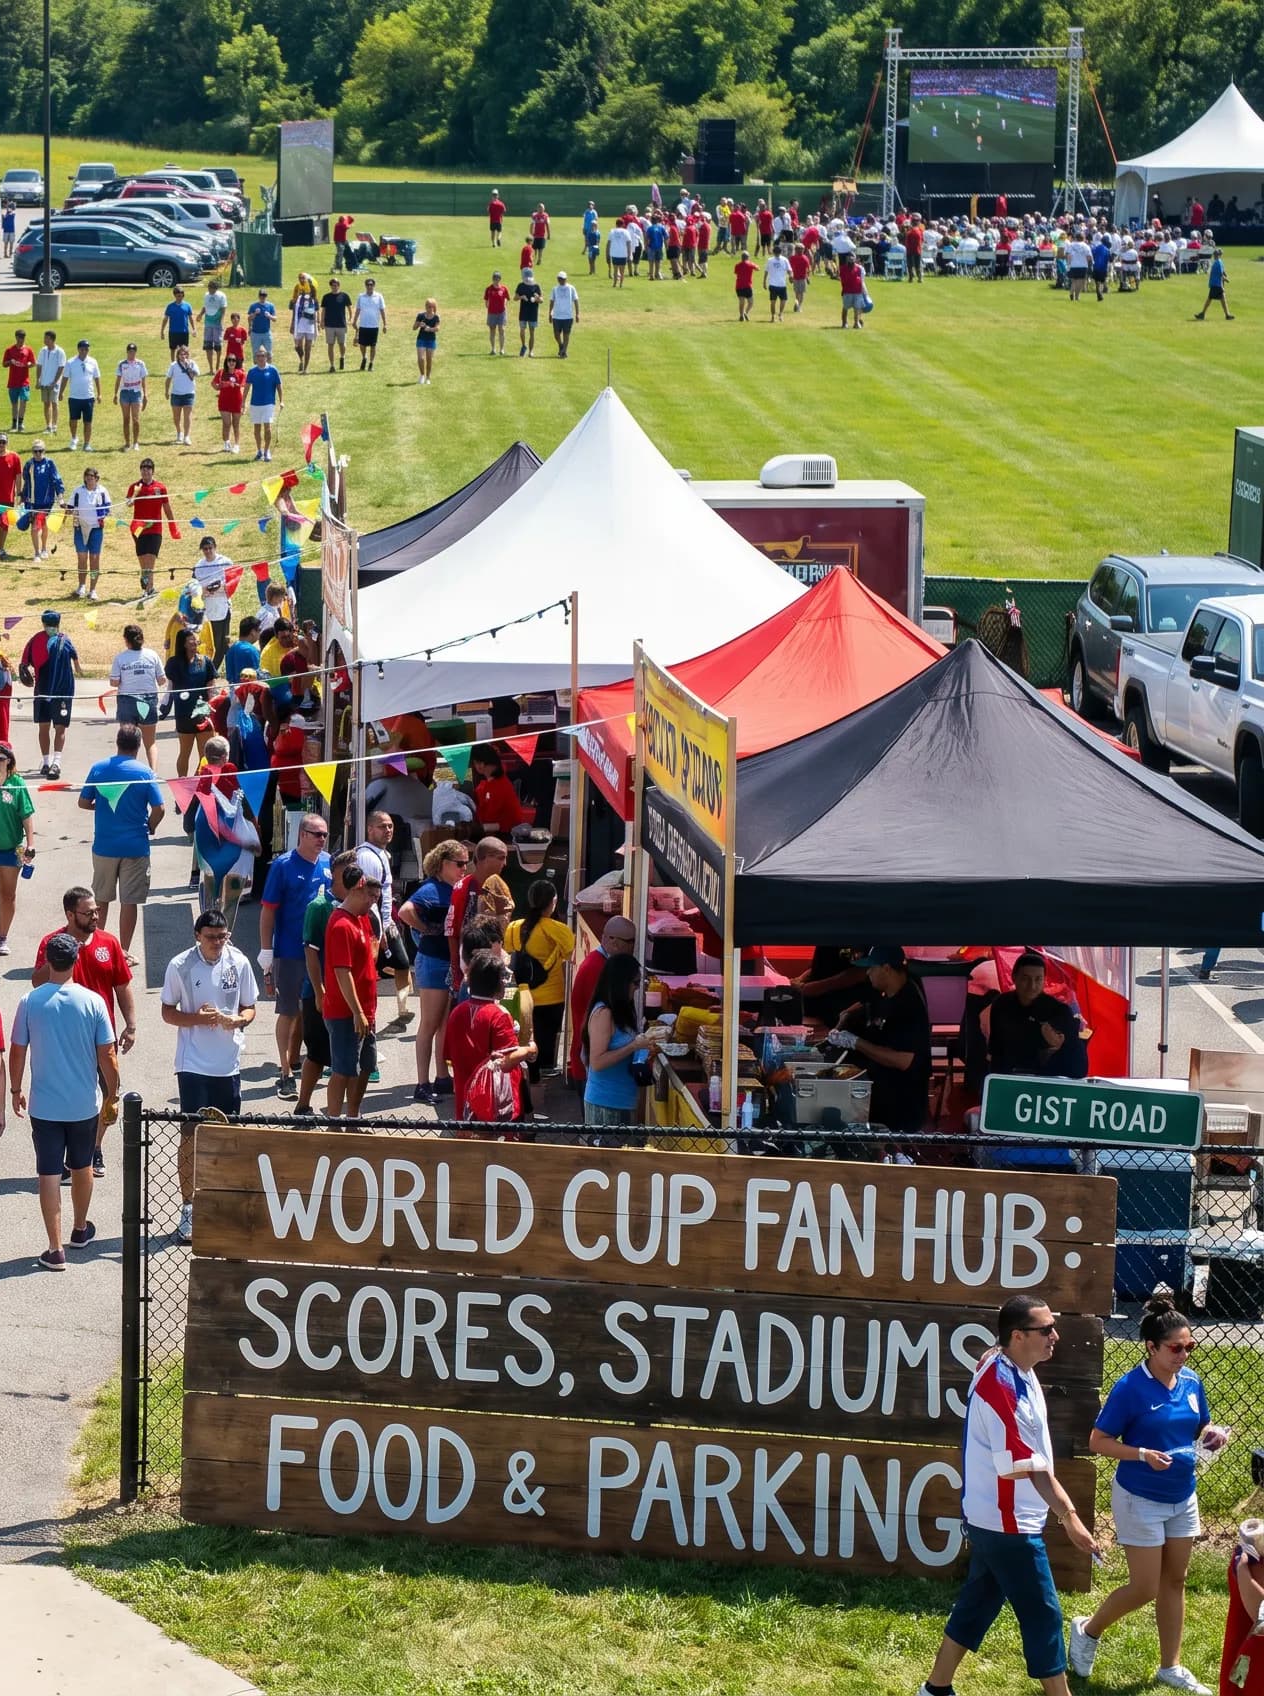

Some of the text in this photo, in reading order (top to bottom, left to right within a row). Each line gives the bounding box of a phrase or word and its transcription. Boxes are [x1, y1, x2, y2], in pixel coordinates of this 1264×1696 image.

[1015, 1093, 1167, 1133] GIST ROAD
[257, 1153, 1083, 1289] WORLD CUP FAN HUB:
[238, 1277, 999, 1419] SCORES, STADIUMS
[266, 1414, 963, 1567] FOOD & PARKING
